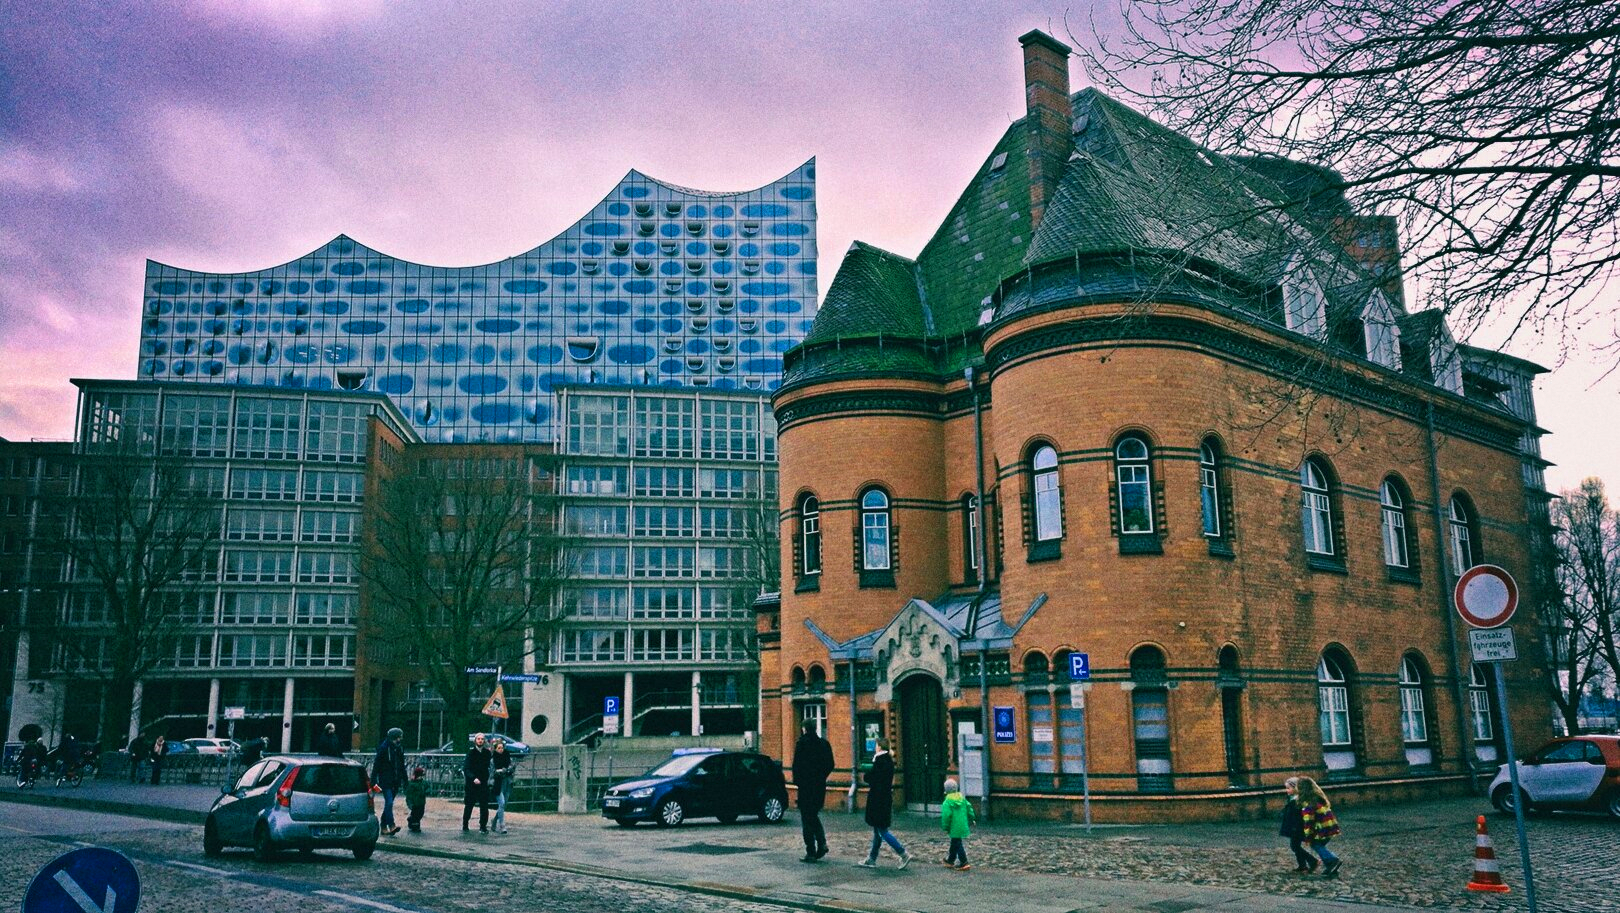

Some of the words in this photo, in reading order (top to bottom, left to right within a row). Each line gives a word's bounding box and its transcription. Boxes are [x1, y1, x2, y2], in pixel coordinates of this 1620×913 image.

[1476, 632, 1506, 640] Einsatz-
[1473, 641, 1511, 650] fahrzeuge
[1072, 656, 1084, 676] P
[29, 682, 45, 694] 75
[606, 699, 615, 713] P
